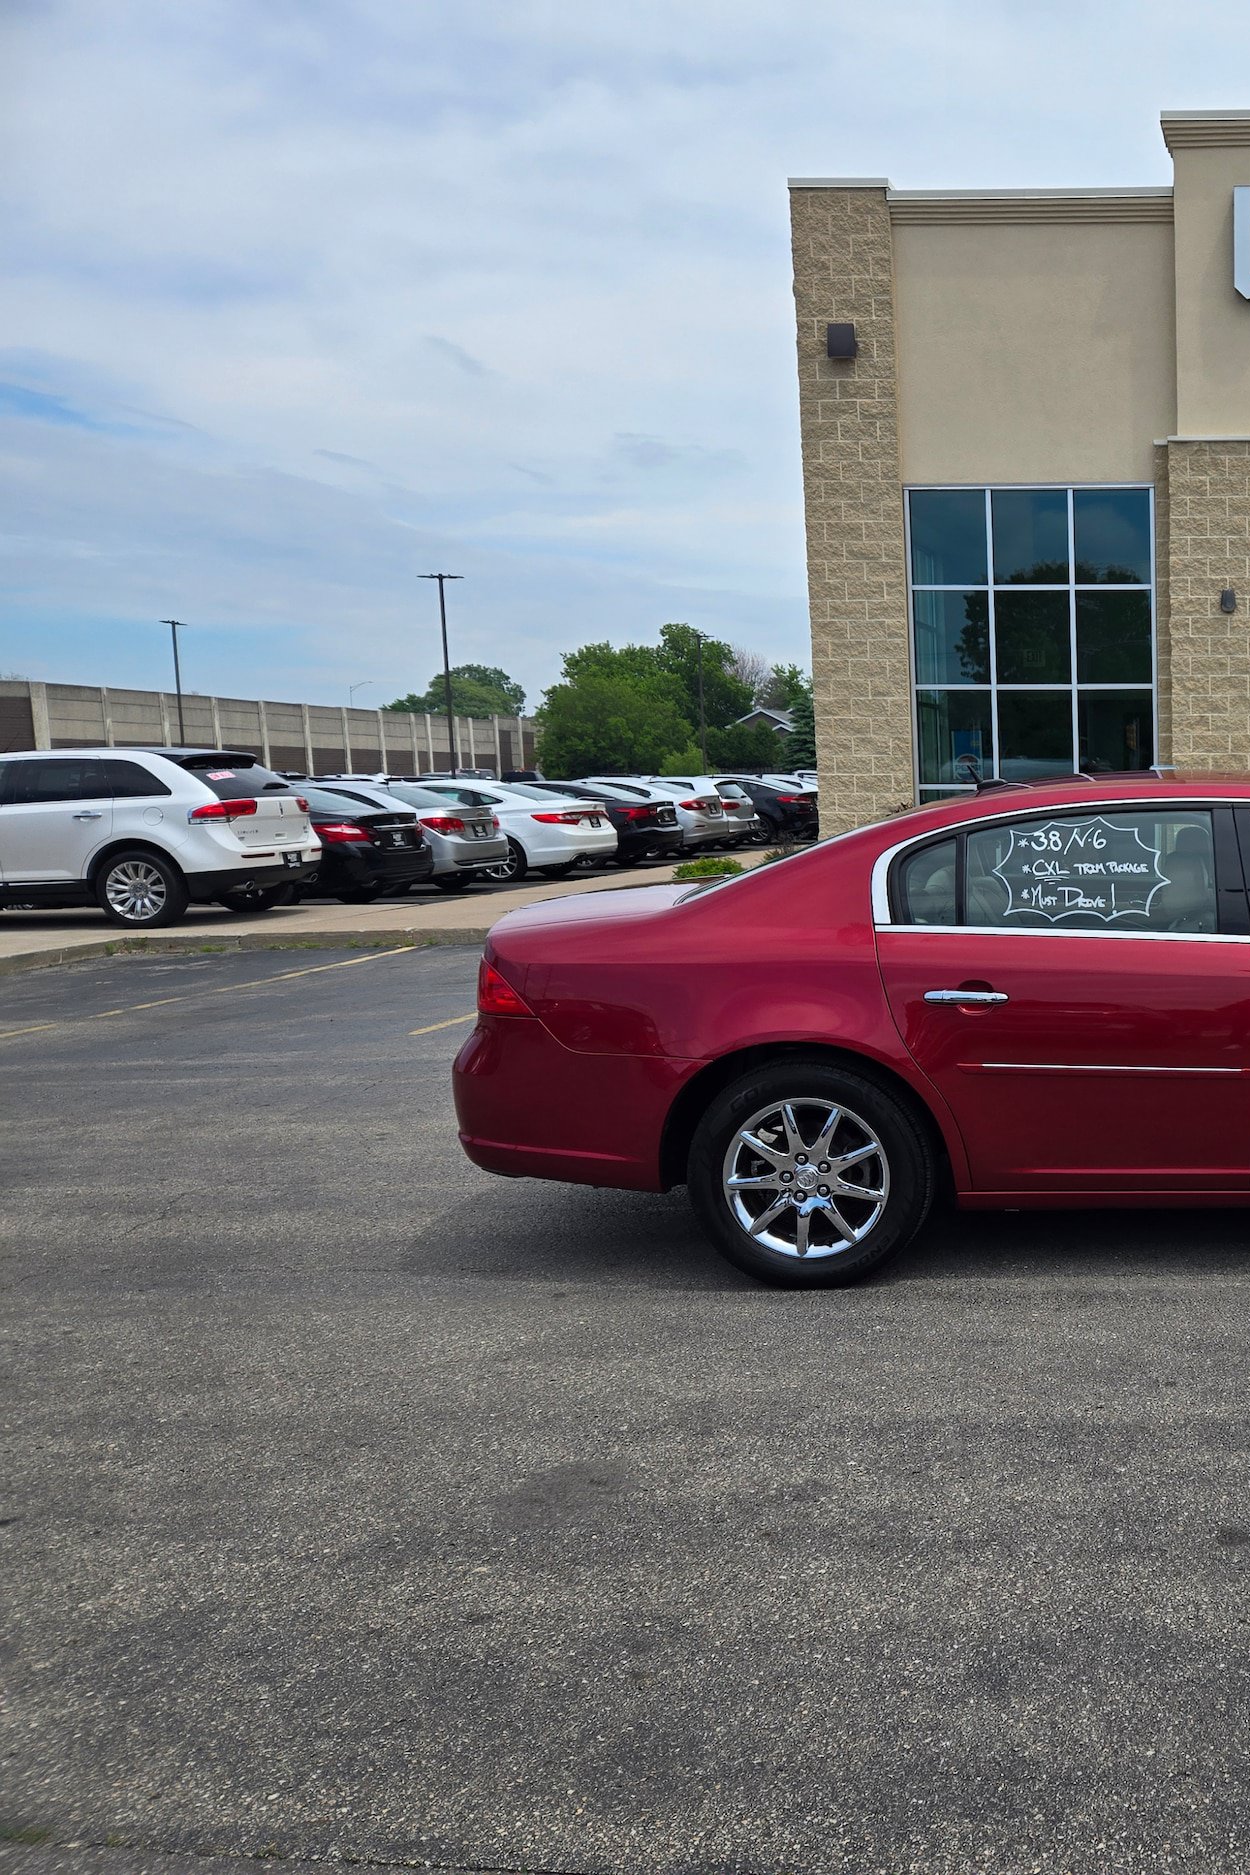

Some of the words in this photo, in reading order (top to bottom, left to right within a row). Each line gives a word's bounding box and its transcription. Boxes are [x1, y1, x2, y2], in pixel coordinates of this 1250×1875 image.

[1032, 859, 1070, 876] CXL
[1073, 862, 1107, 876] TRIM
[1106, 861, 1149, 875] PACKAGE
